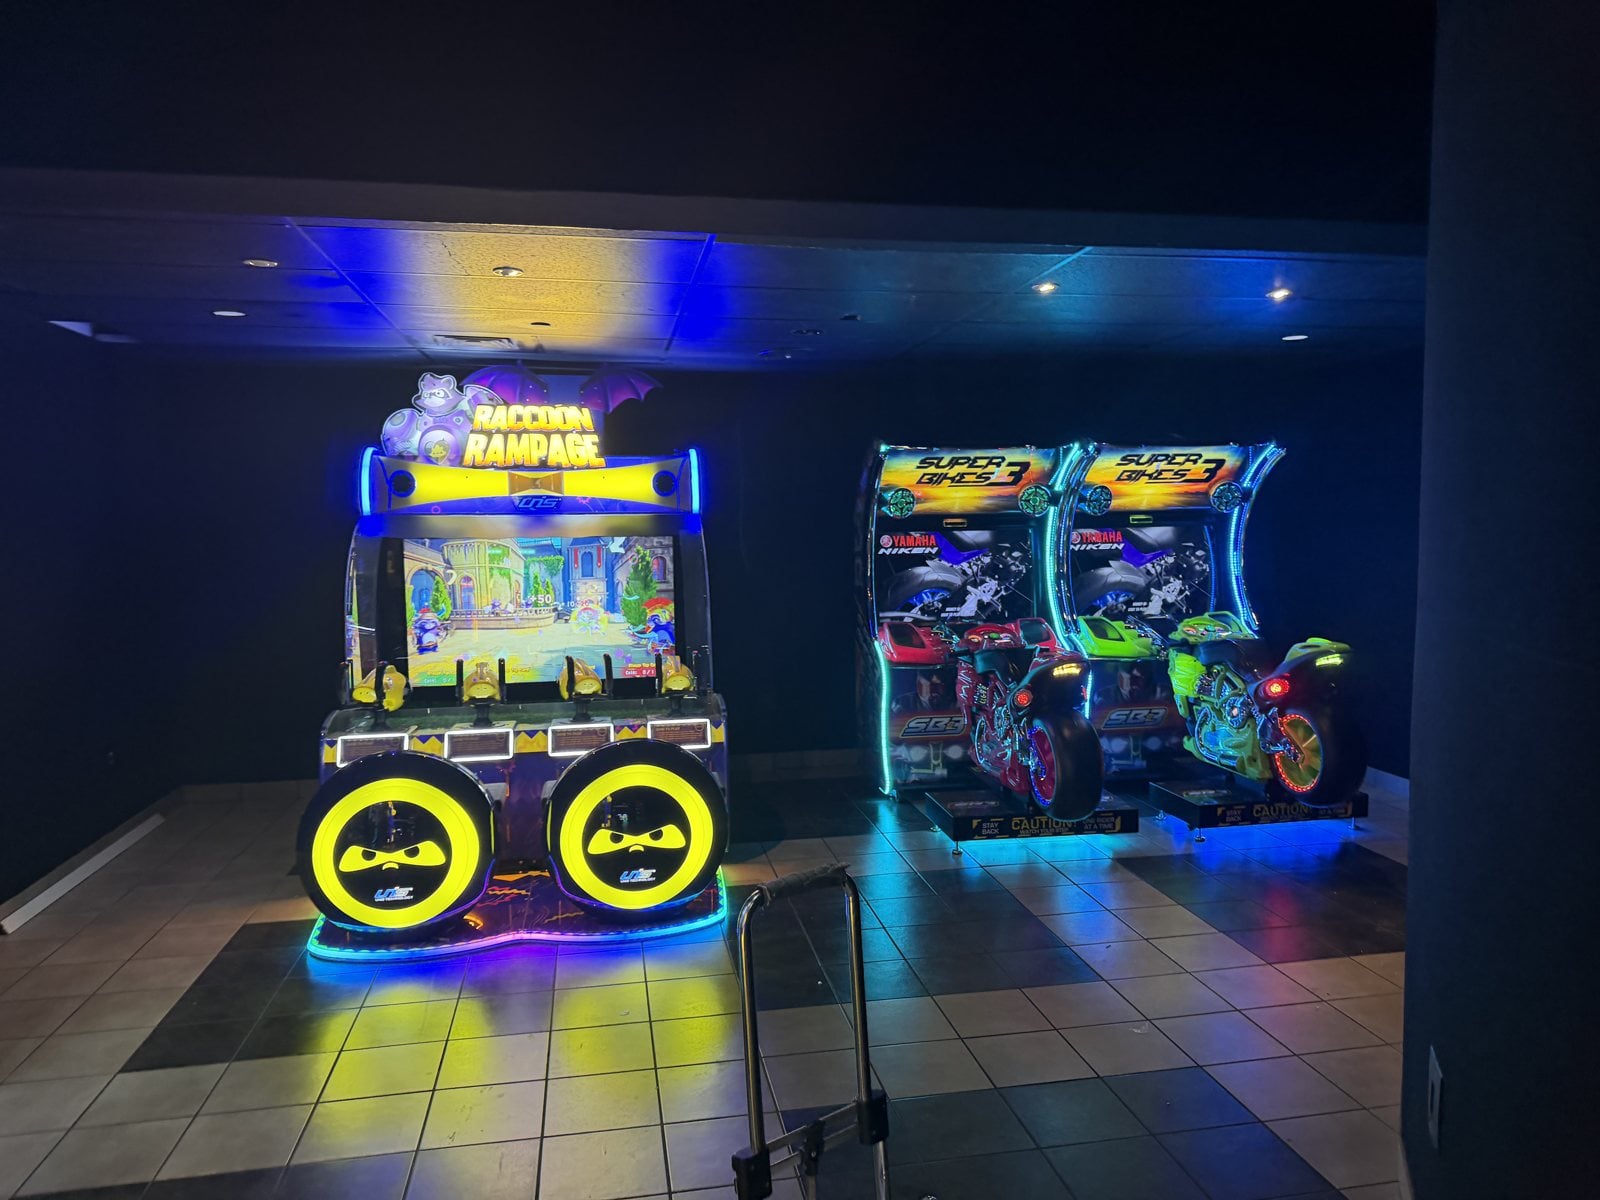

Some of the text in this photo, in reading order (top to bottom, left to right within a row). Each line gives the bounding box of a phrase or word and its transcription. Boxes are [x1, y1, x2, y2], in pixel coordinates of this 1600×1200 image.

[473, 404, 594, 431] RACCOON
[463, 432, 606, 467] RAMPAGE
[916, 456, 1006, 470] SUPER
[1115, 453, 1203, 467] SUPER
[916, 472, 996, 485] BIKES
[1115, 469, 1192, 482] BIKES
[892, 535, 937, 547] YAMAHA
[1081, 531, 1123, 543] YAMAHA
[878, 547, 939, 555] NIKEN
[1071, 543, 1125, 551] NIKEN
